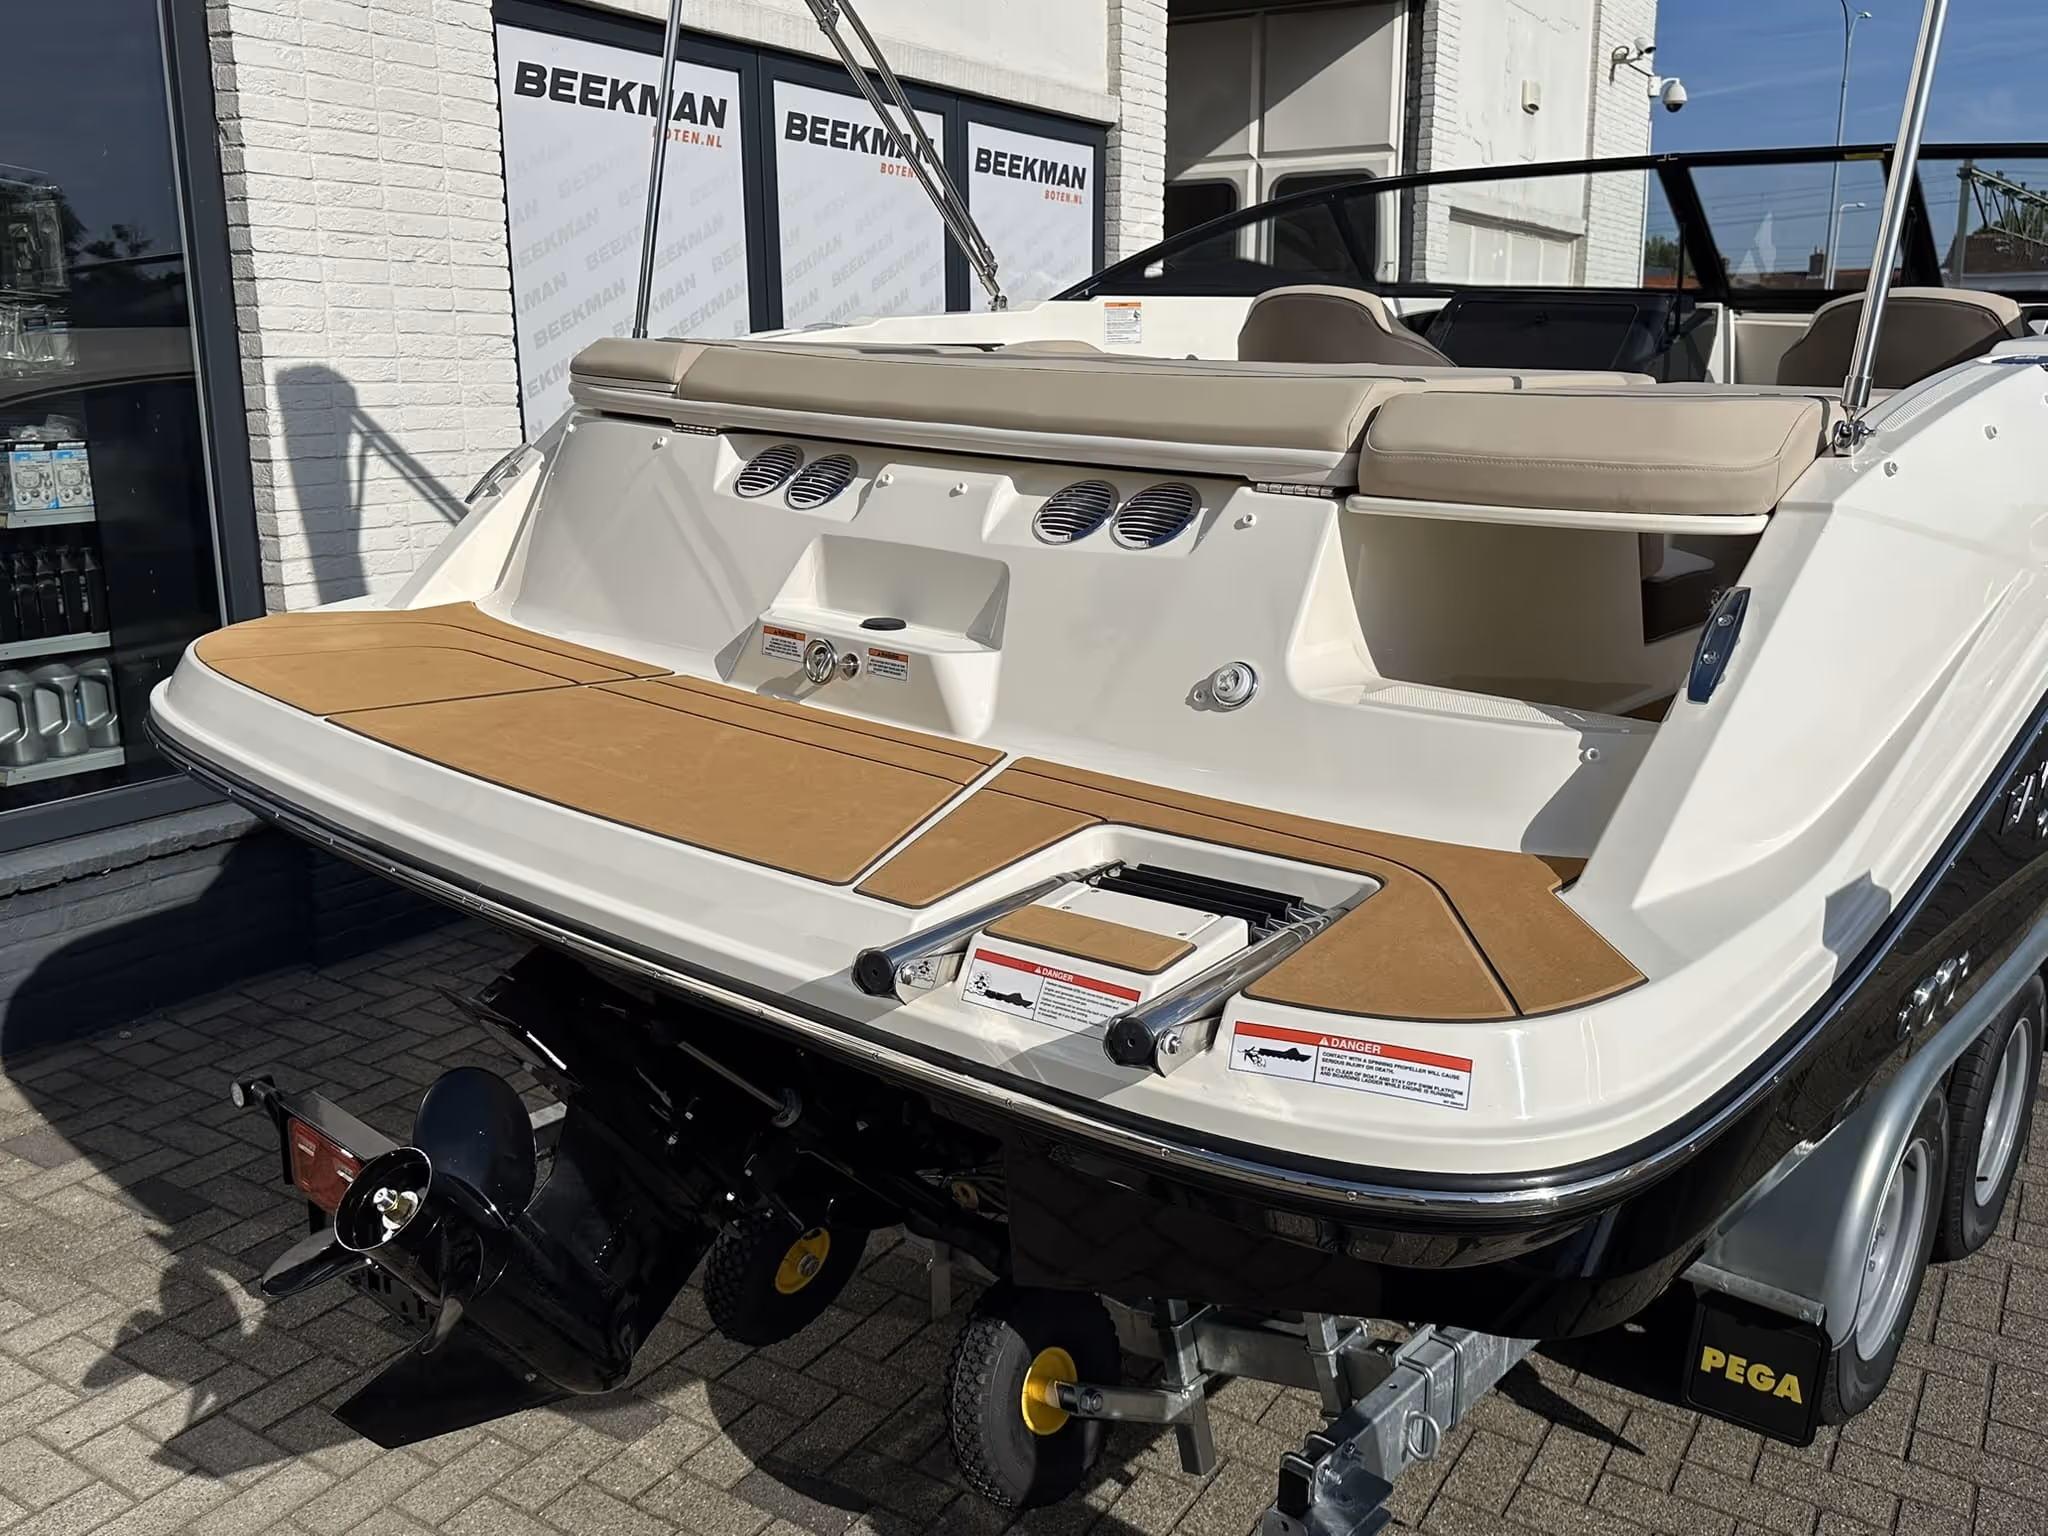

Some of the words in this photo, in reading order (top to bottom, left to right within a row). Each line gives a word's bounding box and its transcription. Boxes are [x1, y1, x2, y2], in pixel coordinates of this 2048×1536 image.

[514, 60, 728, 129] BEEKMAN
[975, 147, 1087, 190] BEEKMAN
[1044, 188, 1083, 205] BOTEN.NL
[533, 277, 627, 351] BEEKMAN
[1042, 967, 1074, 982] DANGER
[1330, 1038, 1382, 1054] DANGER
[1701, 1346, 1802, 1404] PEGA
